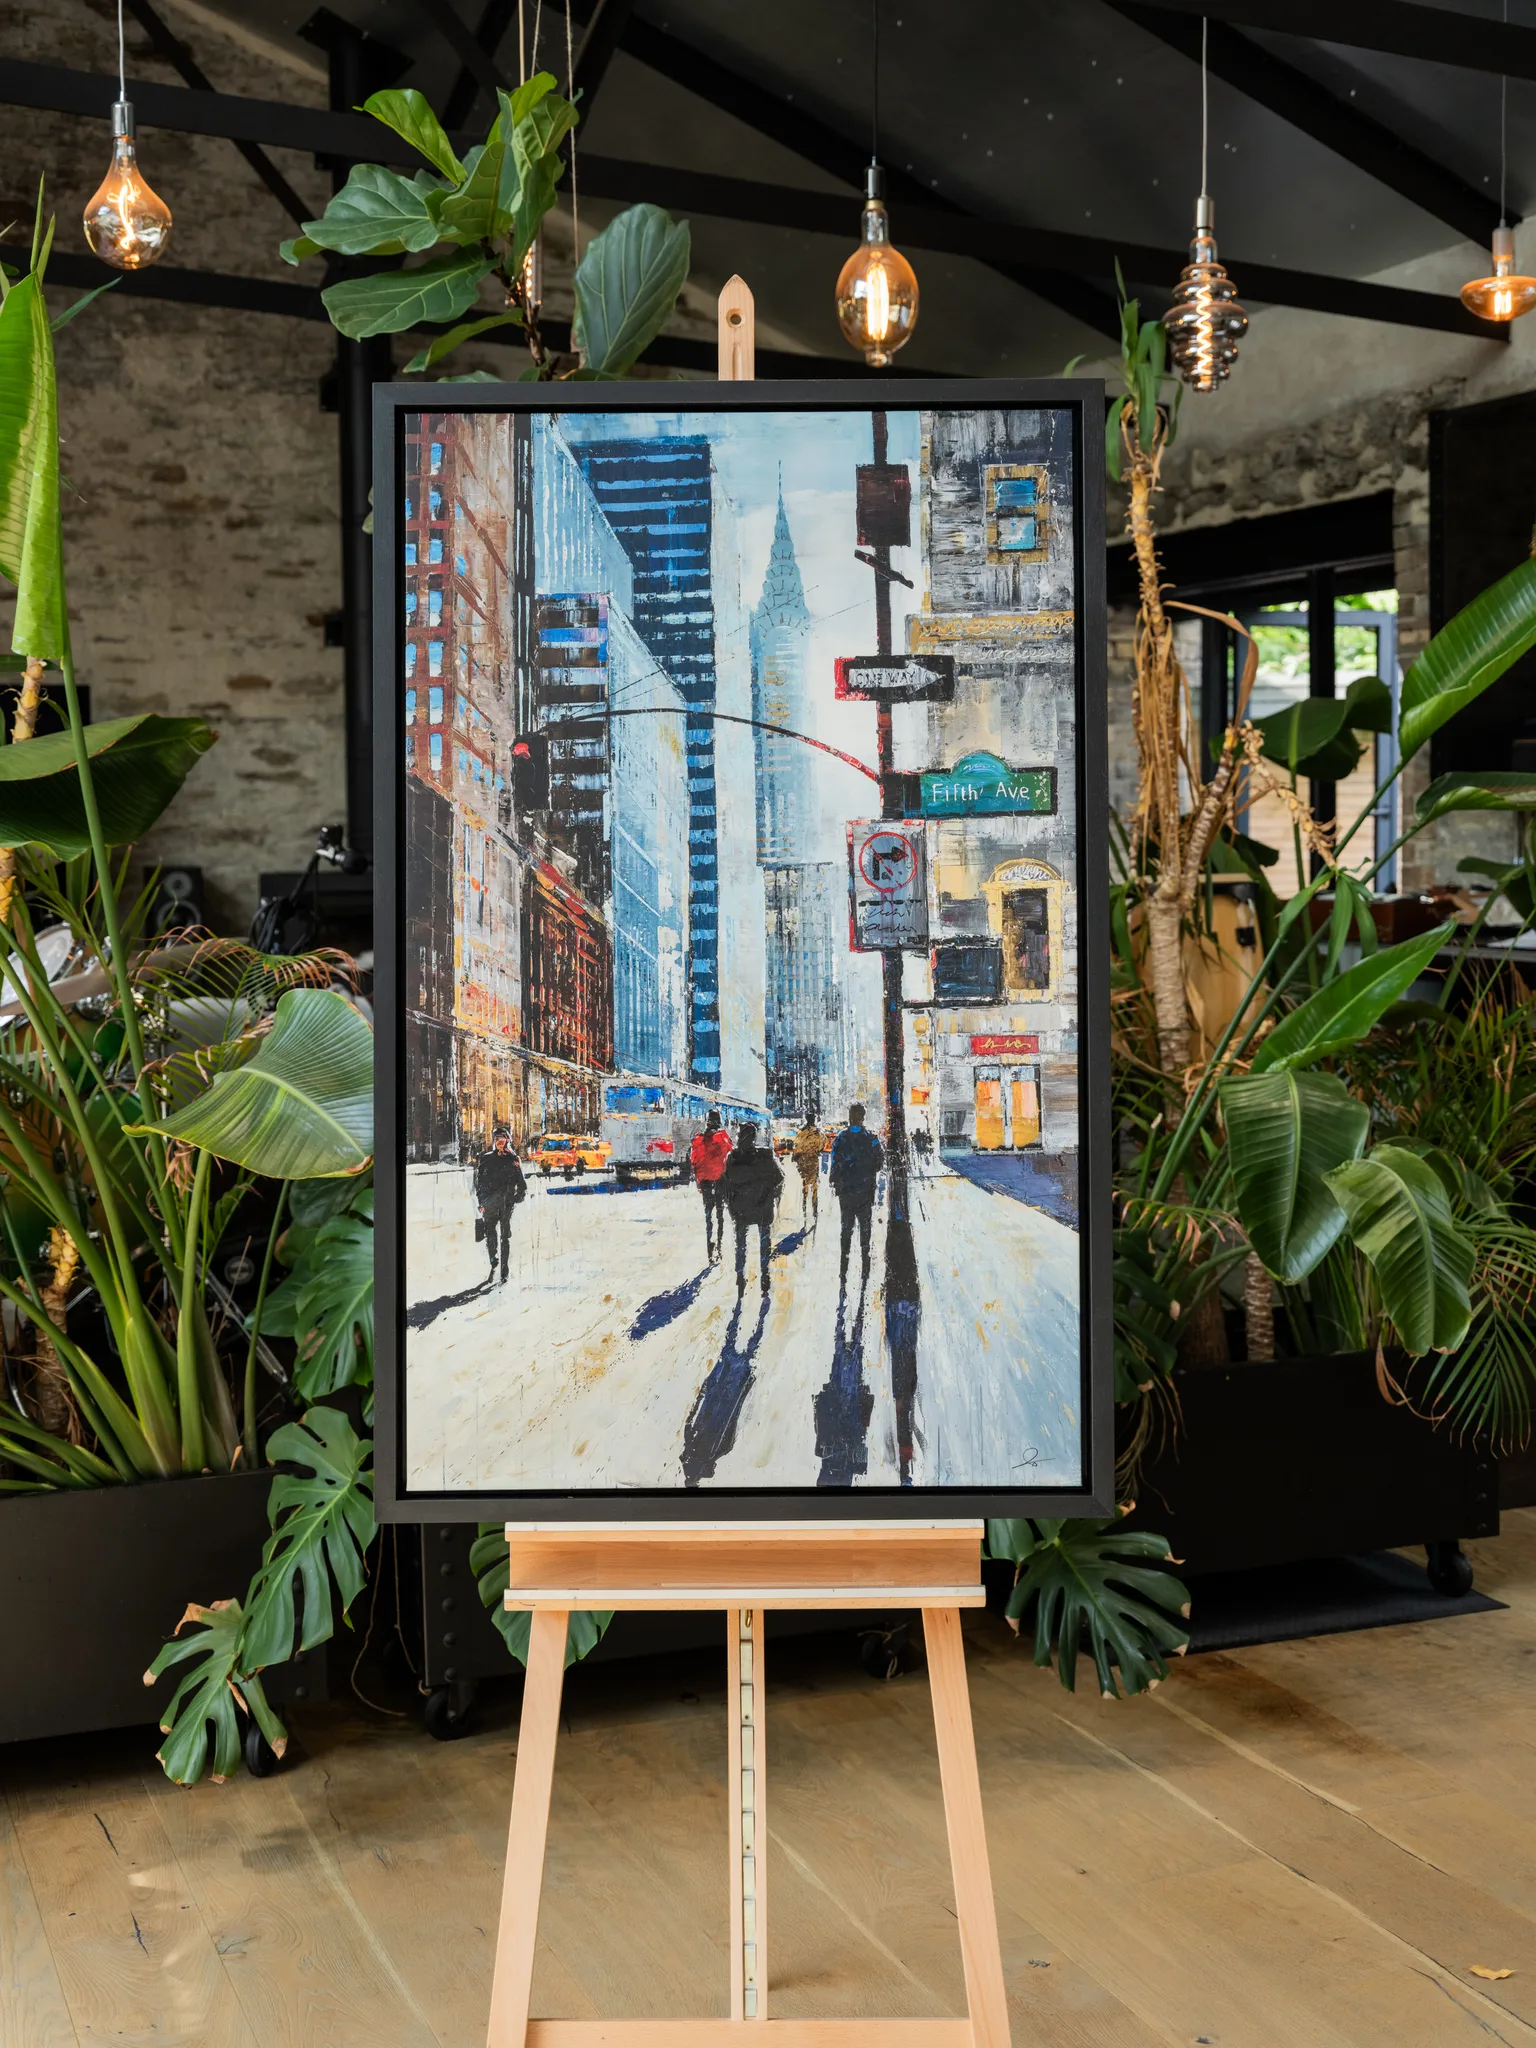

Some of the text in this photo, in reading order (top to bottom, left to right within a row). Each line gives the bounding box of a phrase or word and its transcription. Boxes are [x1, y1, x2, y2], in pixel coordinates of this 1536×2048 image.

[855, 671, 916, 687] ONE WAY
[931, 783, 979, 802] Fifth
